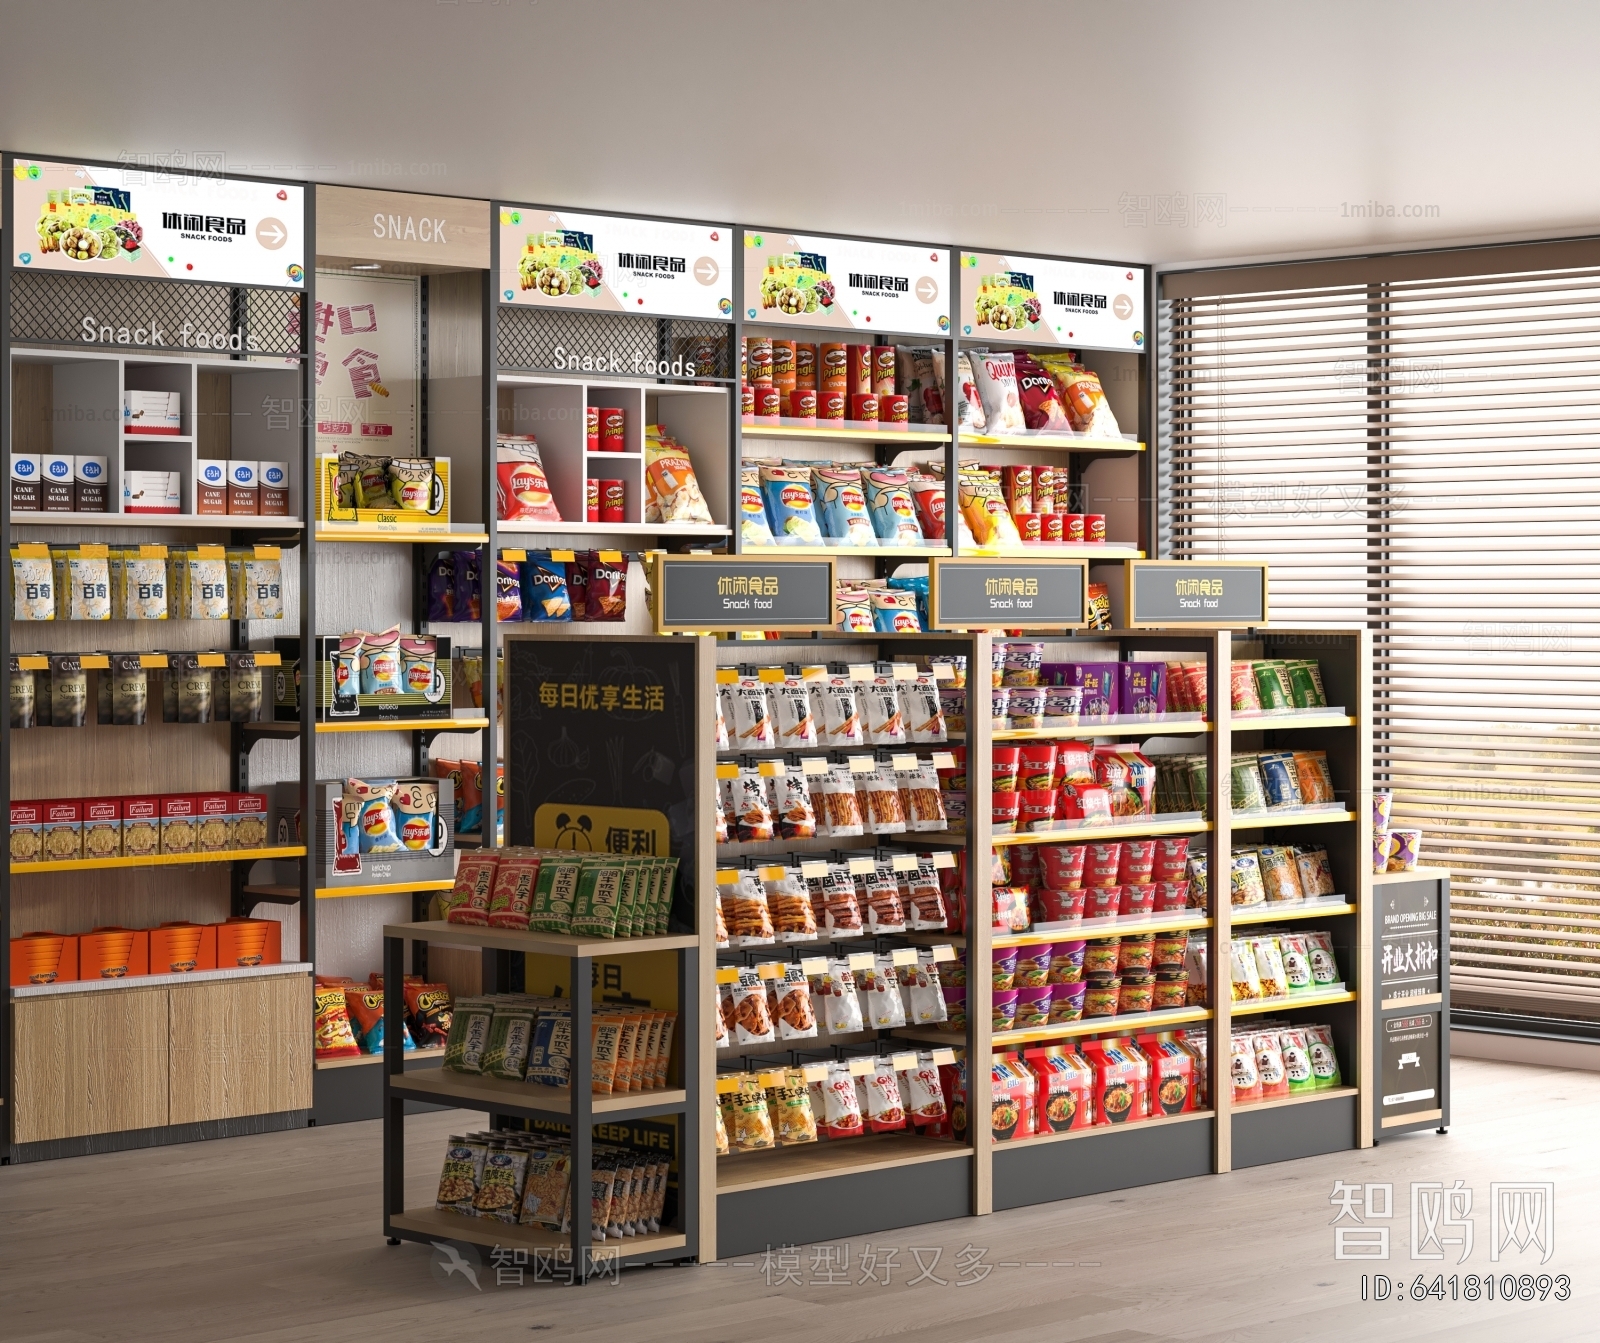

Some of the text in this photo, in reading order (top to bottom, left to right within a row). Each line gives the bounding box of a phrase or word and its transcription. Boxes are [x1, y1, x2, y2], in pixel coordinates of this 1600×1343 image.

[162, 212, 246, 235] 休闲食品
[373, 213, 446, 244] SNACK
[180, 232, 233, 243] SNACK FOODS
[618, 252, 686, 273] 休闲食品
[655, 272, 675, 280] FOODS
[849, 273, 909, 292] 休闲食品
[1053, 291, 1107, 309] 休闲食品
[82, 316, 258, 351] Snack foods
[554, 346, 696, 377] Snack foods
[376, 513, 398, 523] Classic
[26, 583, 51, 599] 百奇
[82, 583, 107, 599] 百奇
[138, 583, 163, 599] 百奇
[201, 583, 225, 599] 百奇
[256, 583, 280, 599] 百奇
[717, 576, 779, 596] 休闲食品
[985, 577, 1038, 596] 休闲食品
[1175, 578, 1223, 596] 休闲食品
[723, 597, 773, 609] Snack food
[989, 598, 1033, 609] Snack food
[1179, 597, 1218, 608] Snack food
[539, 682, 665, 712] 每日优享生活
[91, 807, 114, 816] Failure
[131, 805, 153, 815] Failure
[169, 803, 190, 813] Failure
[204, 801, 226, 811] Failure
[239, 800, 261, 809] Failure
[11, 811, 35, 820] Failure
[51, 809, 75, 818] Failure
[605, 826, 657, 857] 便利
[1384, 910, 1437, 925] BRAND OPENING BIG SALE
[1381, 940, 1438, 975] 开业大折扣
[633, 1130, 670, 1149] LIFE
